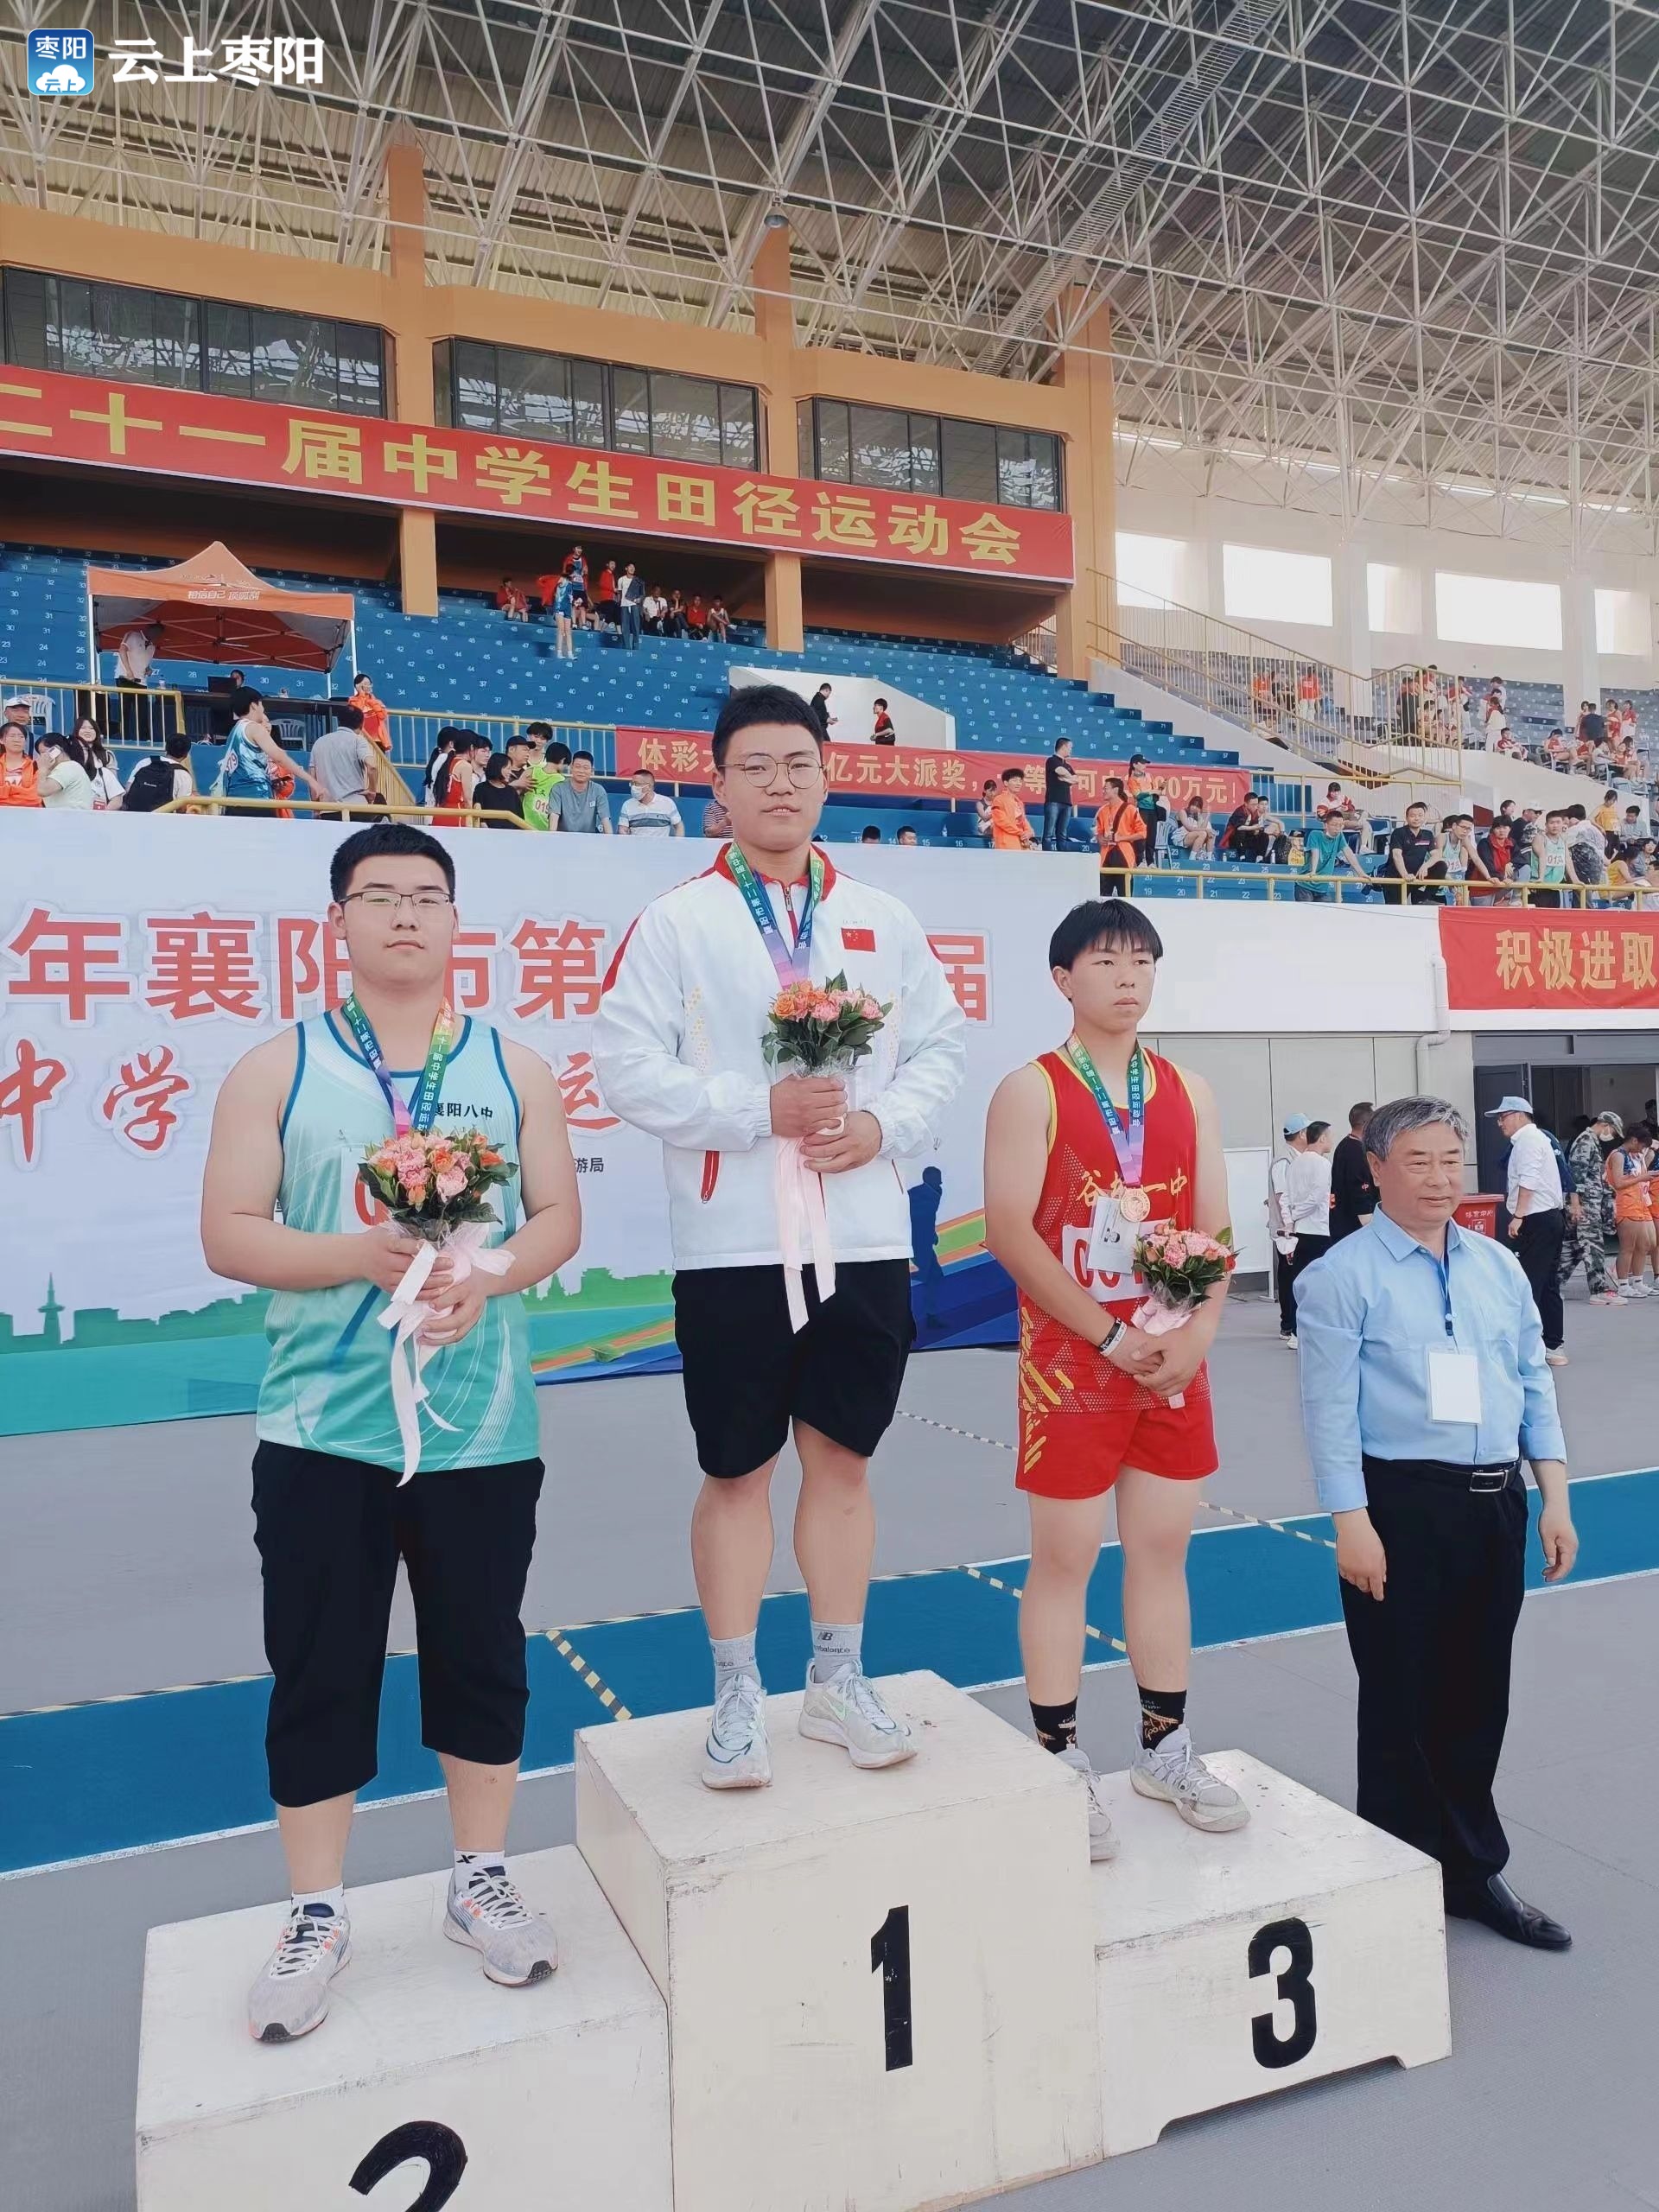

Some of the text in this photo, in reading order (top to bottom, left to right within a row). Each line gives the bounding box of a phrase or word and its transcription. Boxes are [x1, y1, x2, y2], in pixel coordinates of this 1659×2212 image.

[1496, 927, 1657, 990] 积极进取
[871, 1905, 912, 2072] 1
[1248, 1916, 1317, 2069] 3
